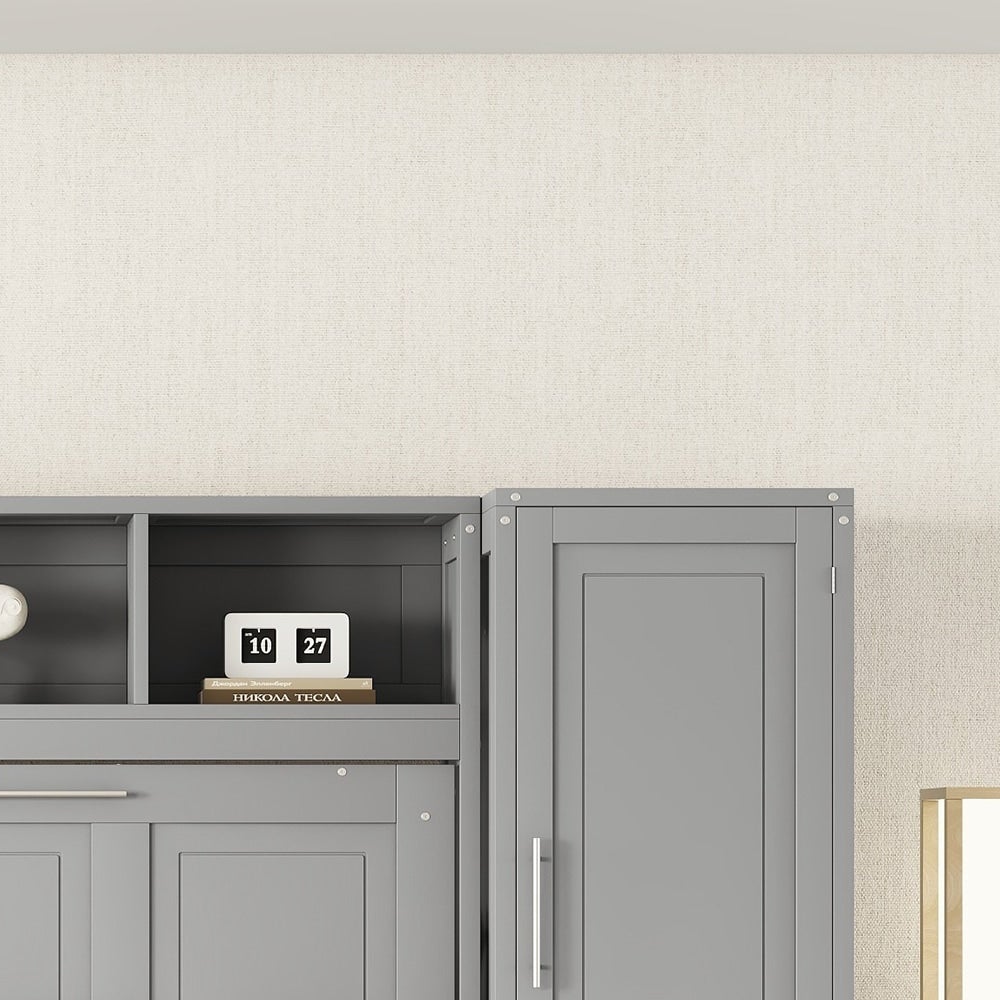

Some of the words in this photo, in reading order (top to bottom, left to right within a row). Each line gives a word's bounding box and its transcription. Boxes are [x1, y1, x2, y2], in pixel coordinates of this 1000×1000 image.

[249, 637, 272, 654] 10
[303, 637, 327, 654] 27
[232, 693, 291, 702] НИКОЛА
[294, 693, 343, 702] ТЕСЛА
